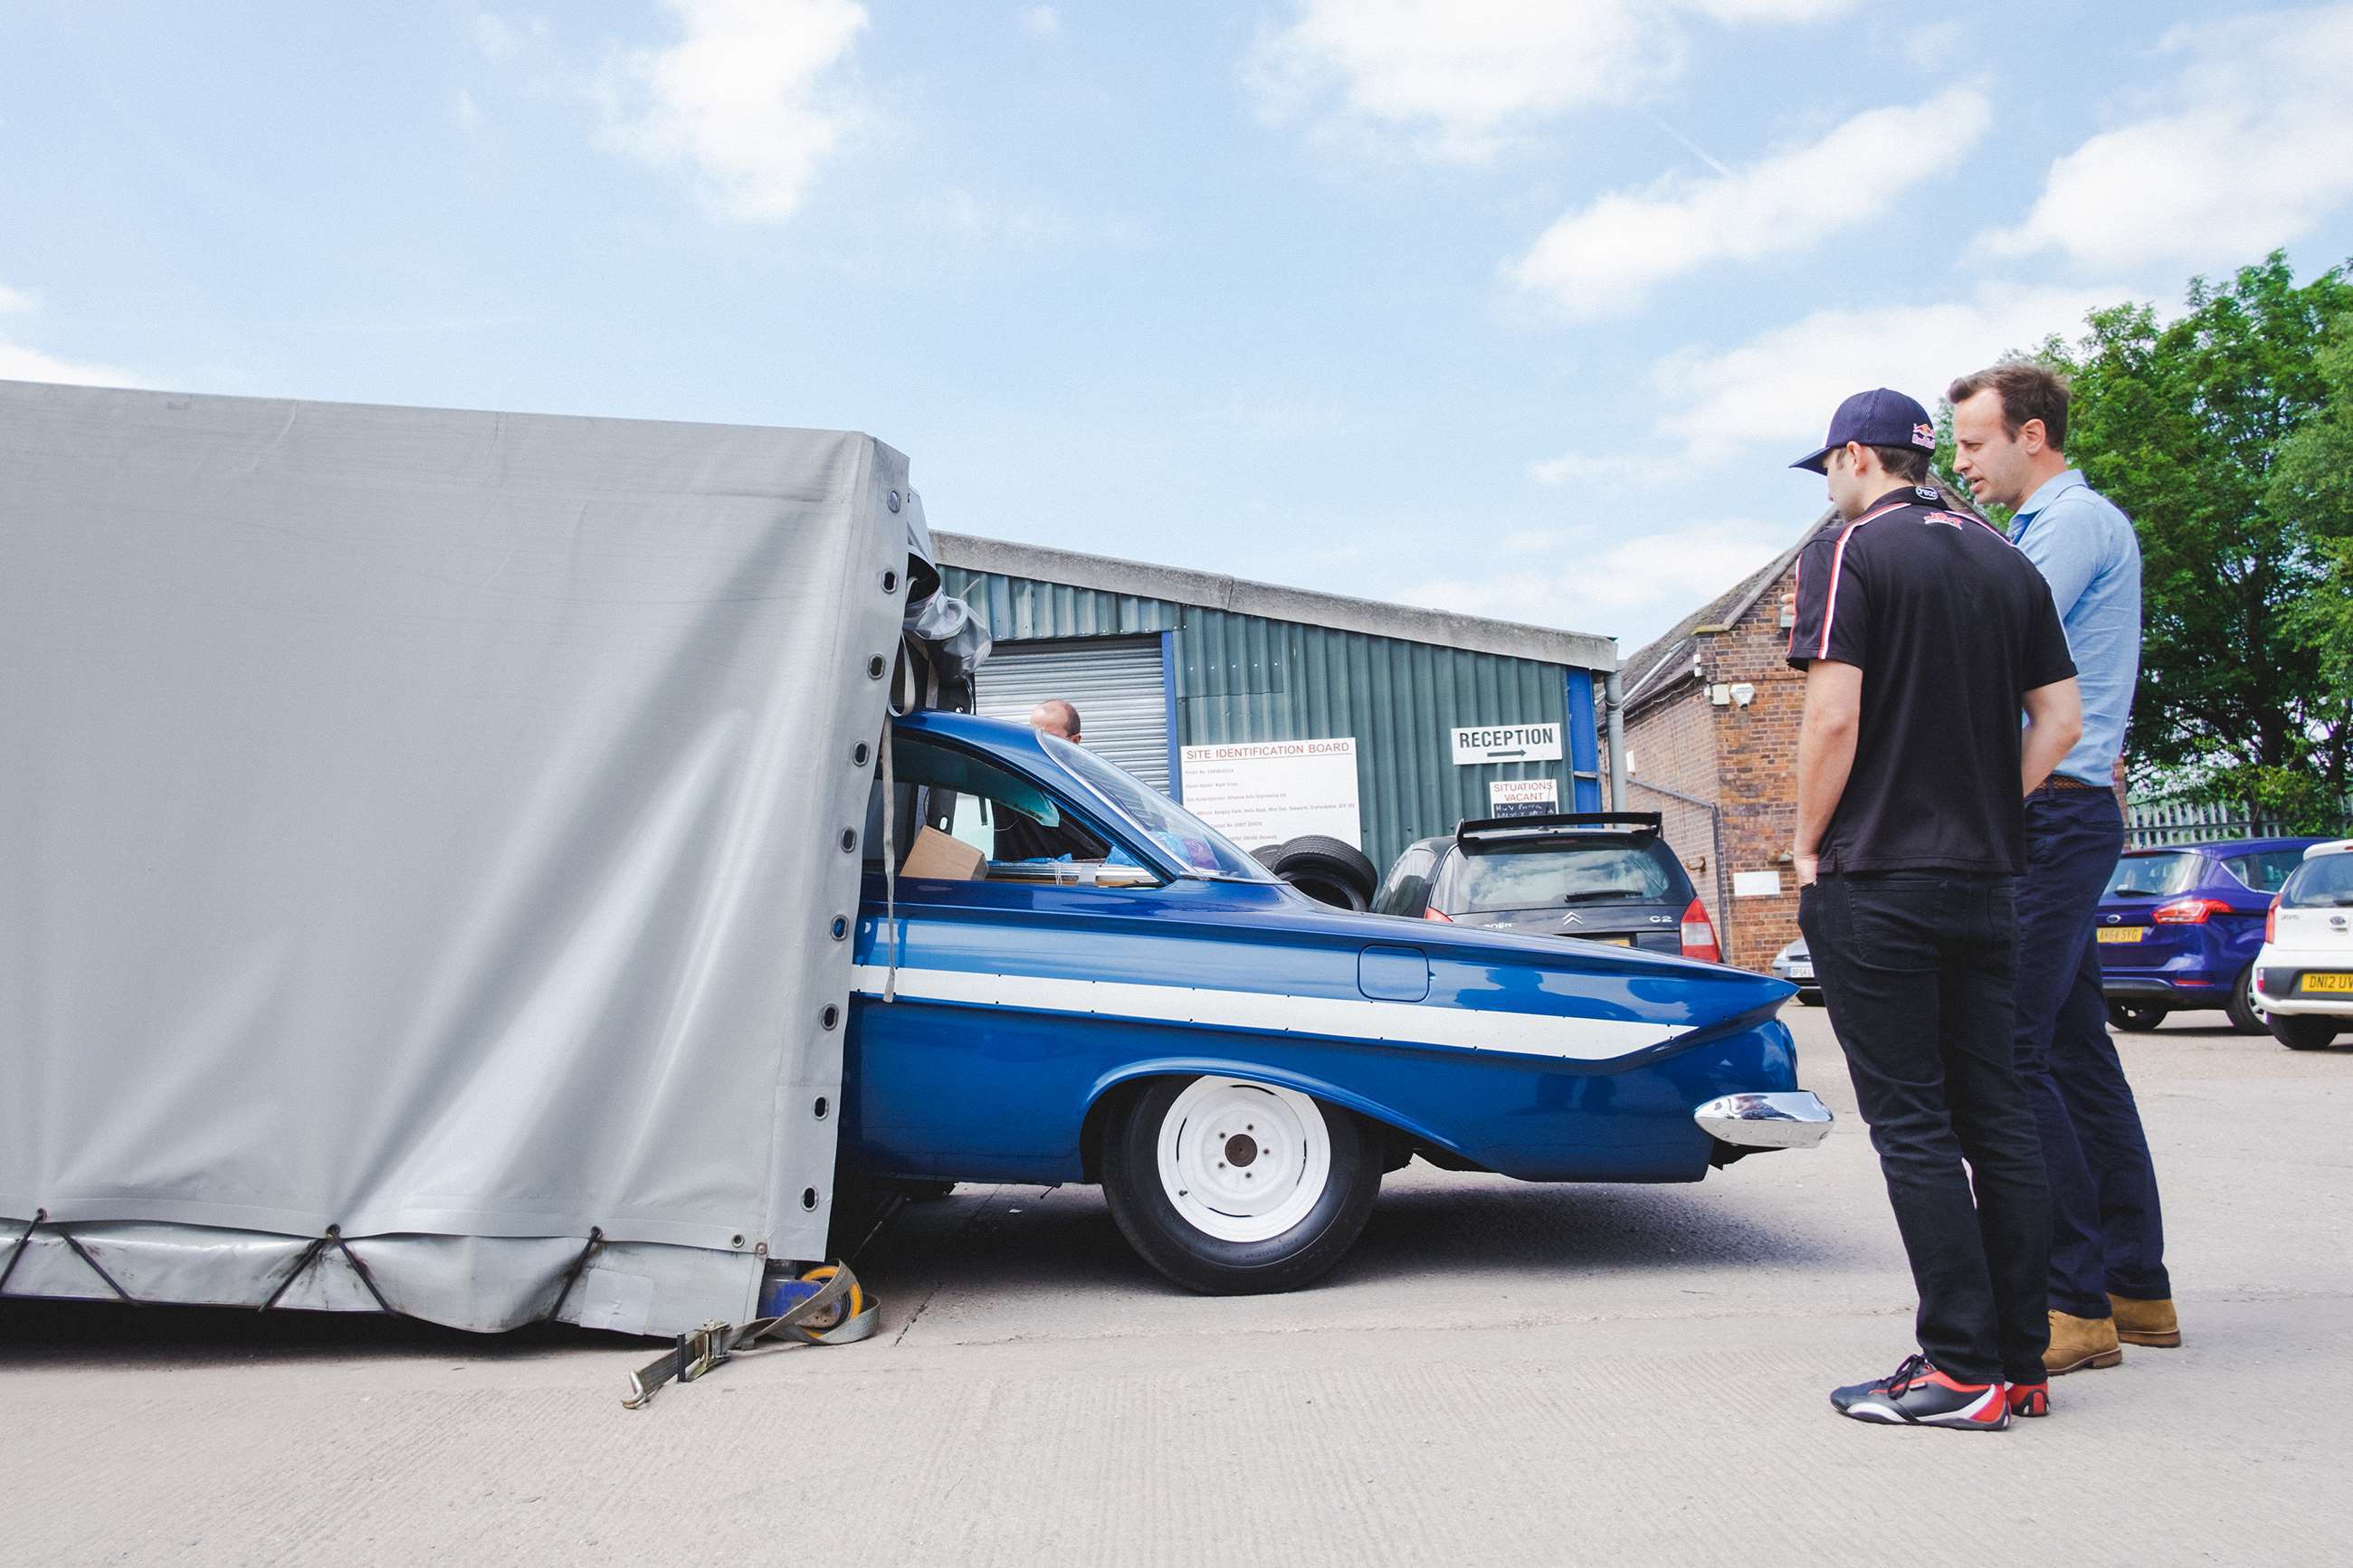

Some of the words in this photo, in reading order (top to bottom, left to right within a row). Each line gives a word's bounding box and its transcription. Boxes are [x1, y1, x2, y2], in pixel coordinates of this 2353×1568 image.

[1459, 727, 1553, 748] RECEPTION
[1186, 749, 1212, 760] SITE
[1215, 744, 1304, 758] IDENTIFICATION
[1309, 742, 1349, 753] BOARD
[1493, 781, 1553, 793] SITUATIONS
[1504, 792, 1544, 802] VACANT
[1649, 915, 1673, 923] C2
[2309, 975, 2336, 989] DN12
